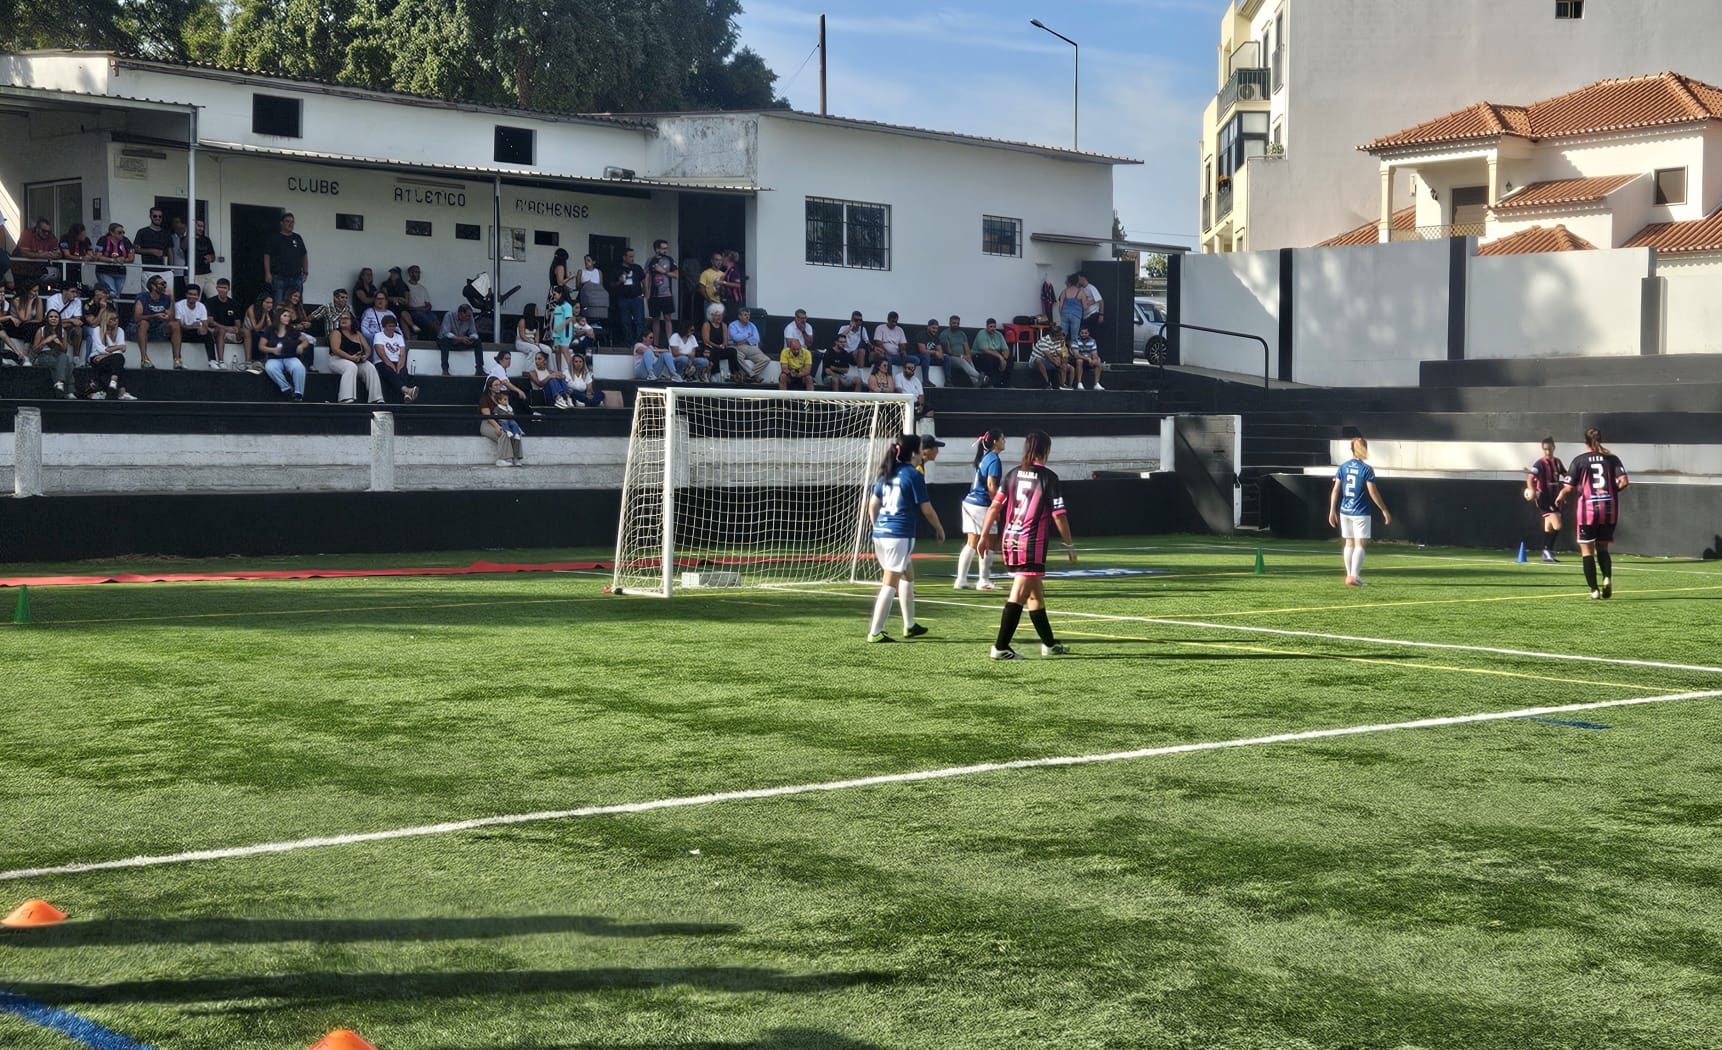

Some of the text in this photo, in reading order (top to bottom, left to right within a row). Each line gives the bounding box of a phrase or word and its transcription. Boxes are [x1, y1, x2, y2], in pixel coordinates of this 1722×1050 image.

[287, 176, 340, 196] CLUBE
[394, 187, 466, 207] ATLETICO
[1345, 474, 1356, 497] 2
[1590, 463, 1605, 489] 3
[1014, 480, 1032, 516] 5
